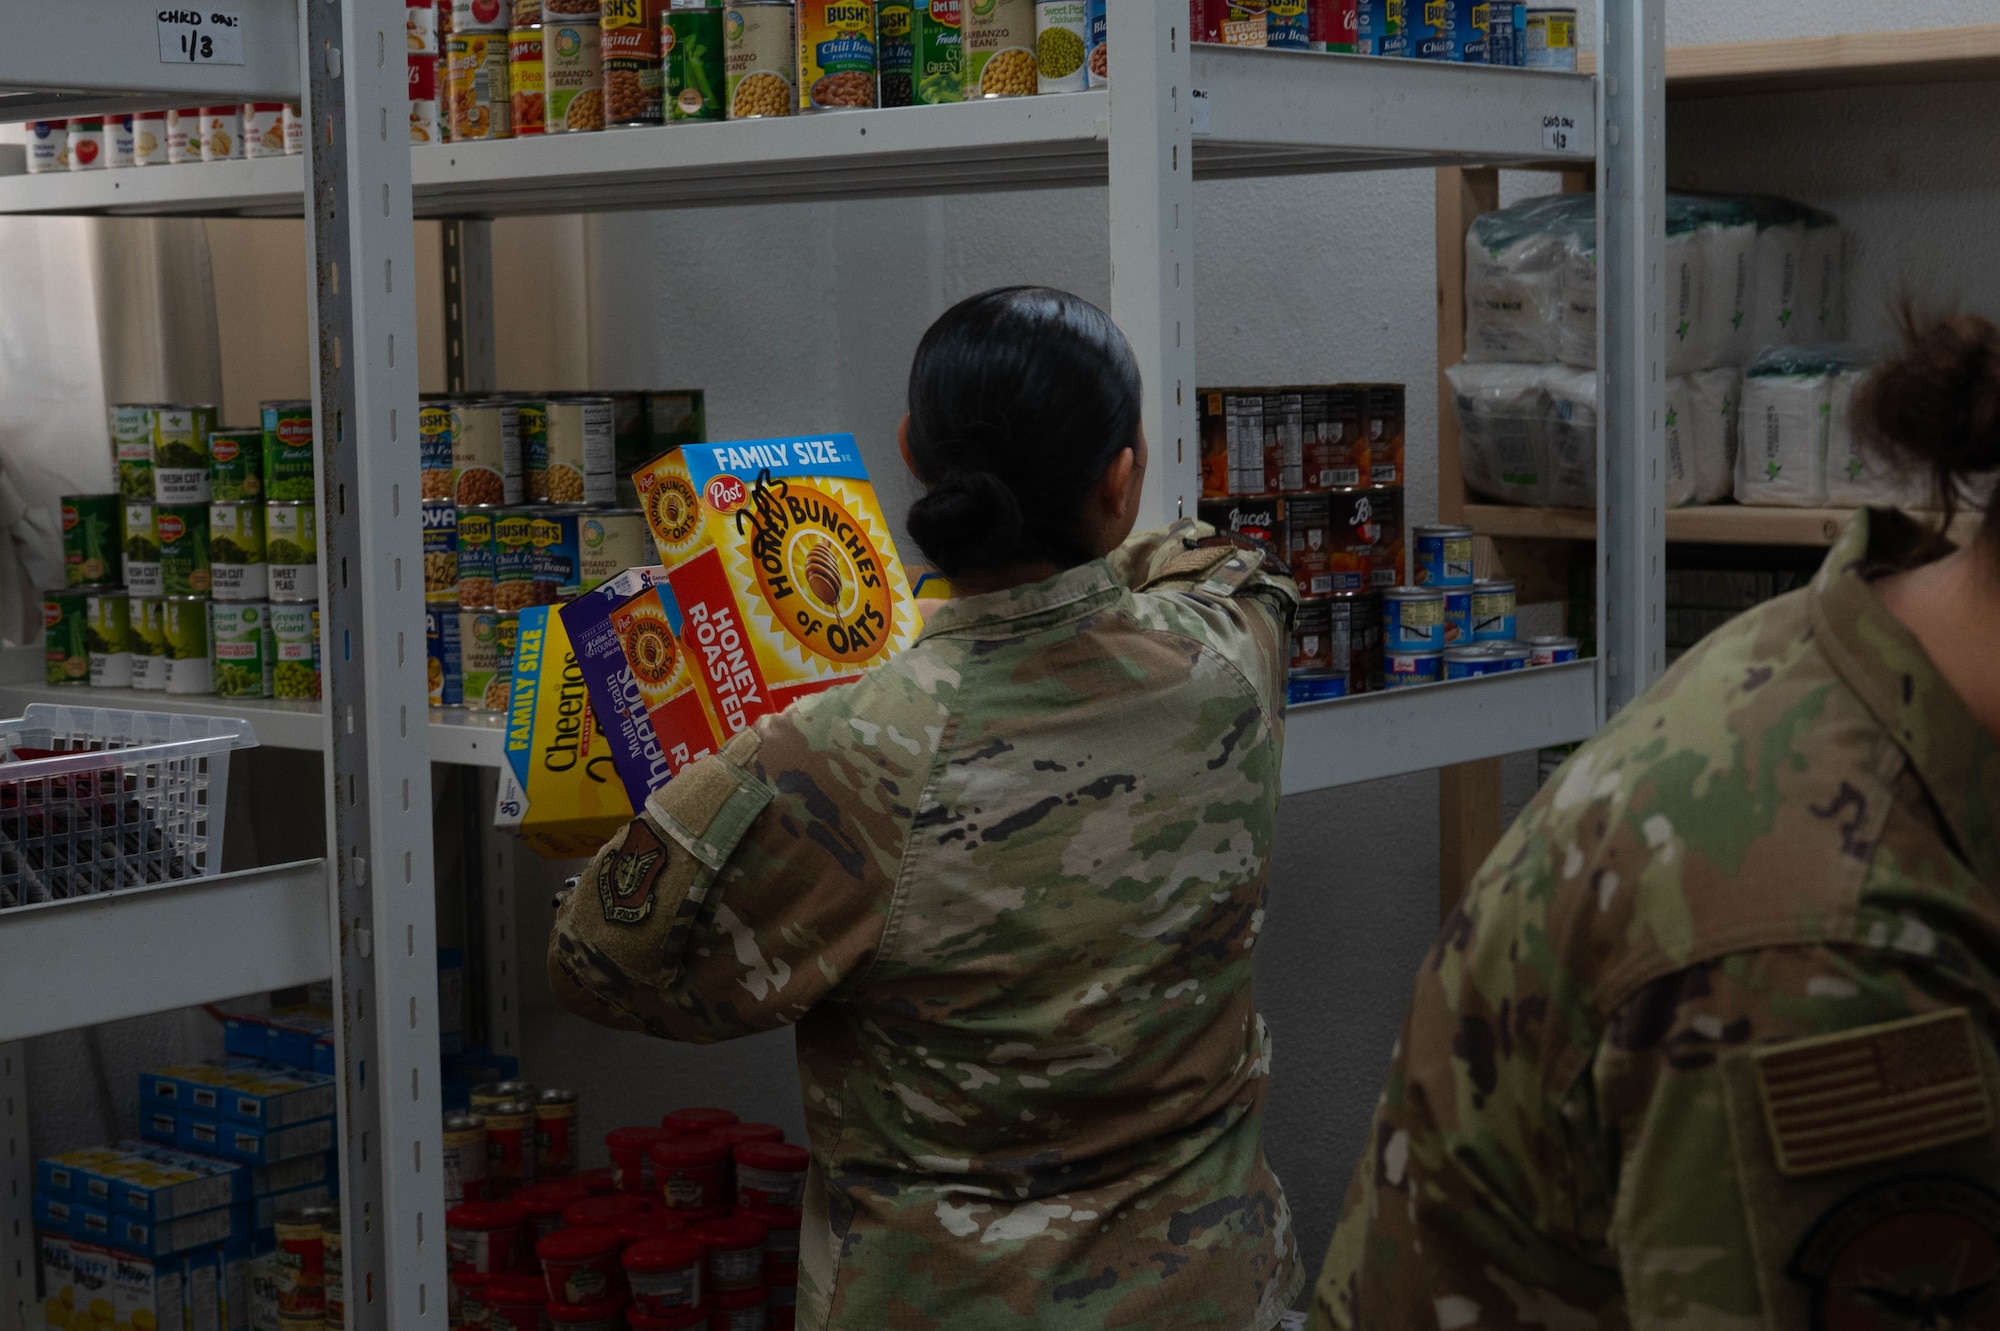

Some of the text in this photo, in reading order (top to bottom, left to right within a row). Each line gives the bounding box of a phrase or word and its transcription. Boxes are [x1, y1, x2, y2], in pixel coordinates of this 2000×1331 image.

[602, 0, 637, 18] SH'S
[827, 6, 870, 24] BUSH'S
[933, 1, 947, 12] Del
[1069, 5, 1084, 14] Pea
[1389, 2, 1401, 17] BU
[1427, 5, 1442, 20] BU
[158, 10, 238, 27] CHKD ON:
[1474, 8, 1488, 24] BU
[970, 39, 998, 48] BEANS
[1225, 31, 1266, 42] NOOD
[181, 30, 213, 61] 1/3
[822, 41, 850, 55] Chili
[946, 48, 962, 61] CU
[927, 61, 958, 74] GREEN
[1553, 130, 1566, 150] 1/3
[712, 440, 841, 471] FAMILY SIZE
[160, 472, 201, 484] FRESH CUT
[639, 475, 655, 492] Post
[651, 480, 695, 526] HONEY BUNCHES
[710, 481, 743, 509] Post
[672, 514, 695, 539] OATS
[786, 495, 881, 588] BUNCHES
[228, 568, 244, 579] CUT
[272, 568, 297, 579] SWEET
[275, 580, 295, 591] PEAS
[214, 612, 237, 620] reen
[273, 610, 305, 620] Green
[275, 621, 305, 633] Giant
[637, 621, 671, 649] BUNCHES
[827, 602, 885, 654] OATS
[517, 628, 543, 672] SIZE
[592, 636, 618, 654] FOUNDA
[711, 607, 762, 704] HONEY
[652, 656, 672, 680] OATS
[689, 601, 746, 733] ROASTED
[508, 679, 536, 751] FAMILY
[545, 652, 584, 772] Cheerios
[606, 673, 642, 759] Multi Grain
